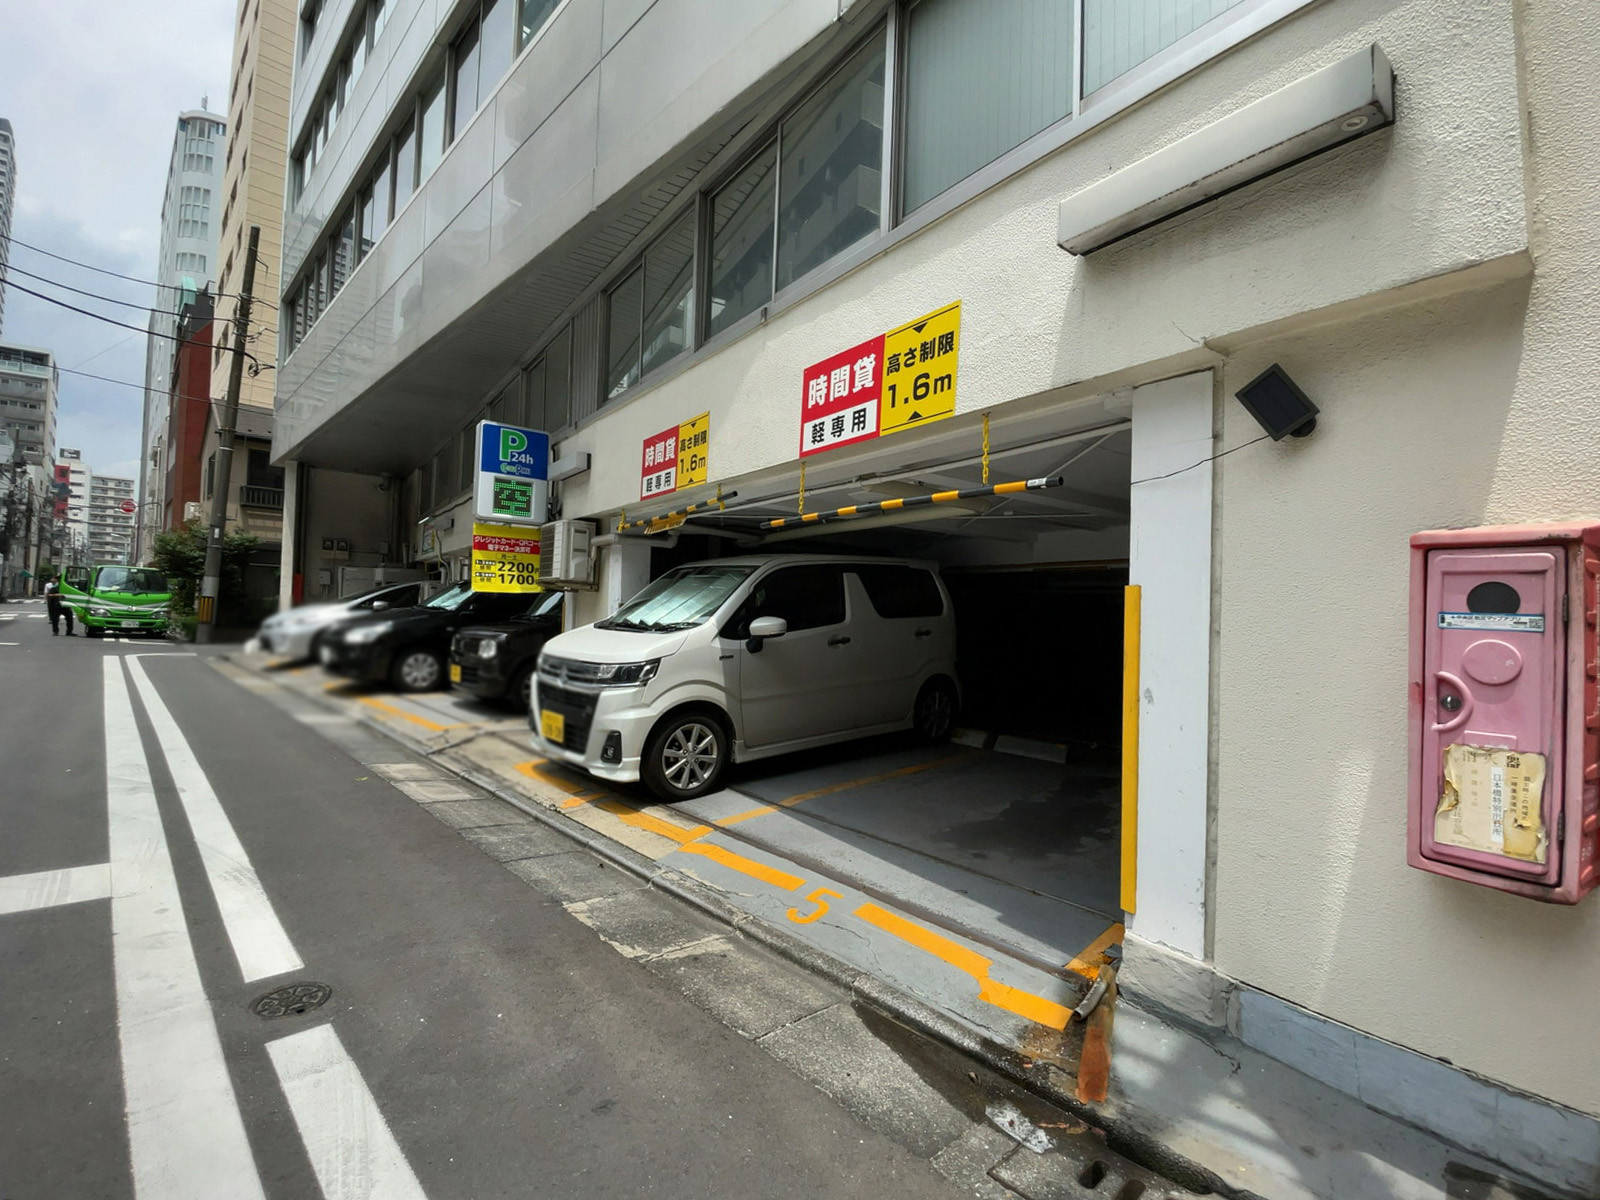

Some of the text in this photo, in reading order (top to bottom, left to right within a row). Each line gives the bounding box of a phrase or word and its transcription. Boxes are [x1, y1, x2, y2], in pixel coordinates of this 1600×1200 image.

[886, 330, 955, 376] 高さ制限
[807, 353, 876, 409] 時間貸
[888, 372, 952, 408] 1.6m
[680, 430, 707, 453] 高さ制限
[811, 407, 867, 445] 軽専用
[499, 427, 528, 462] P
[512, 452, 534, 464] 24h
[645, 436, 676, 468] 時間貸
[680, 454, 706, 474] 1.6m
[493, 480, 533, 518] 空
[786, 887, 844, 924] 5
